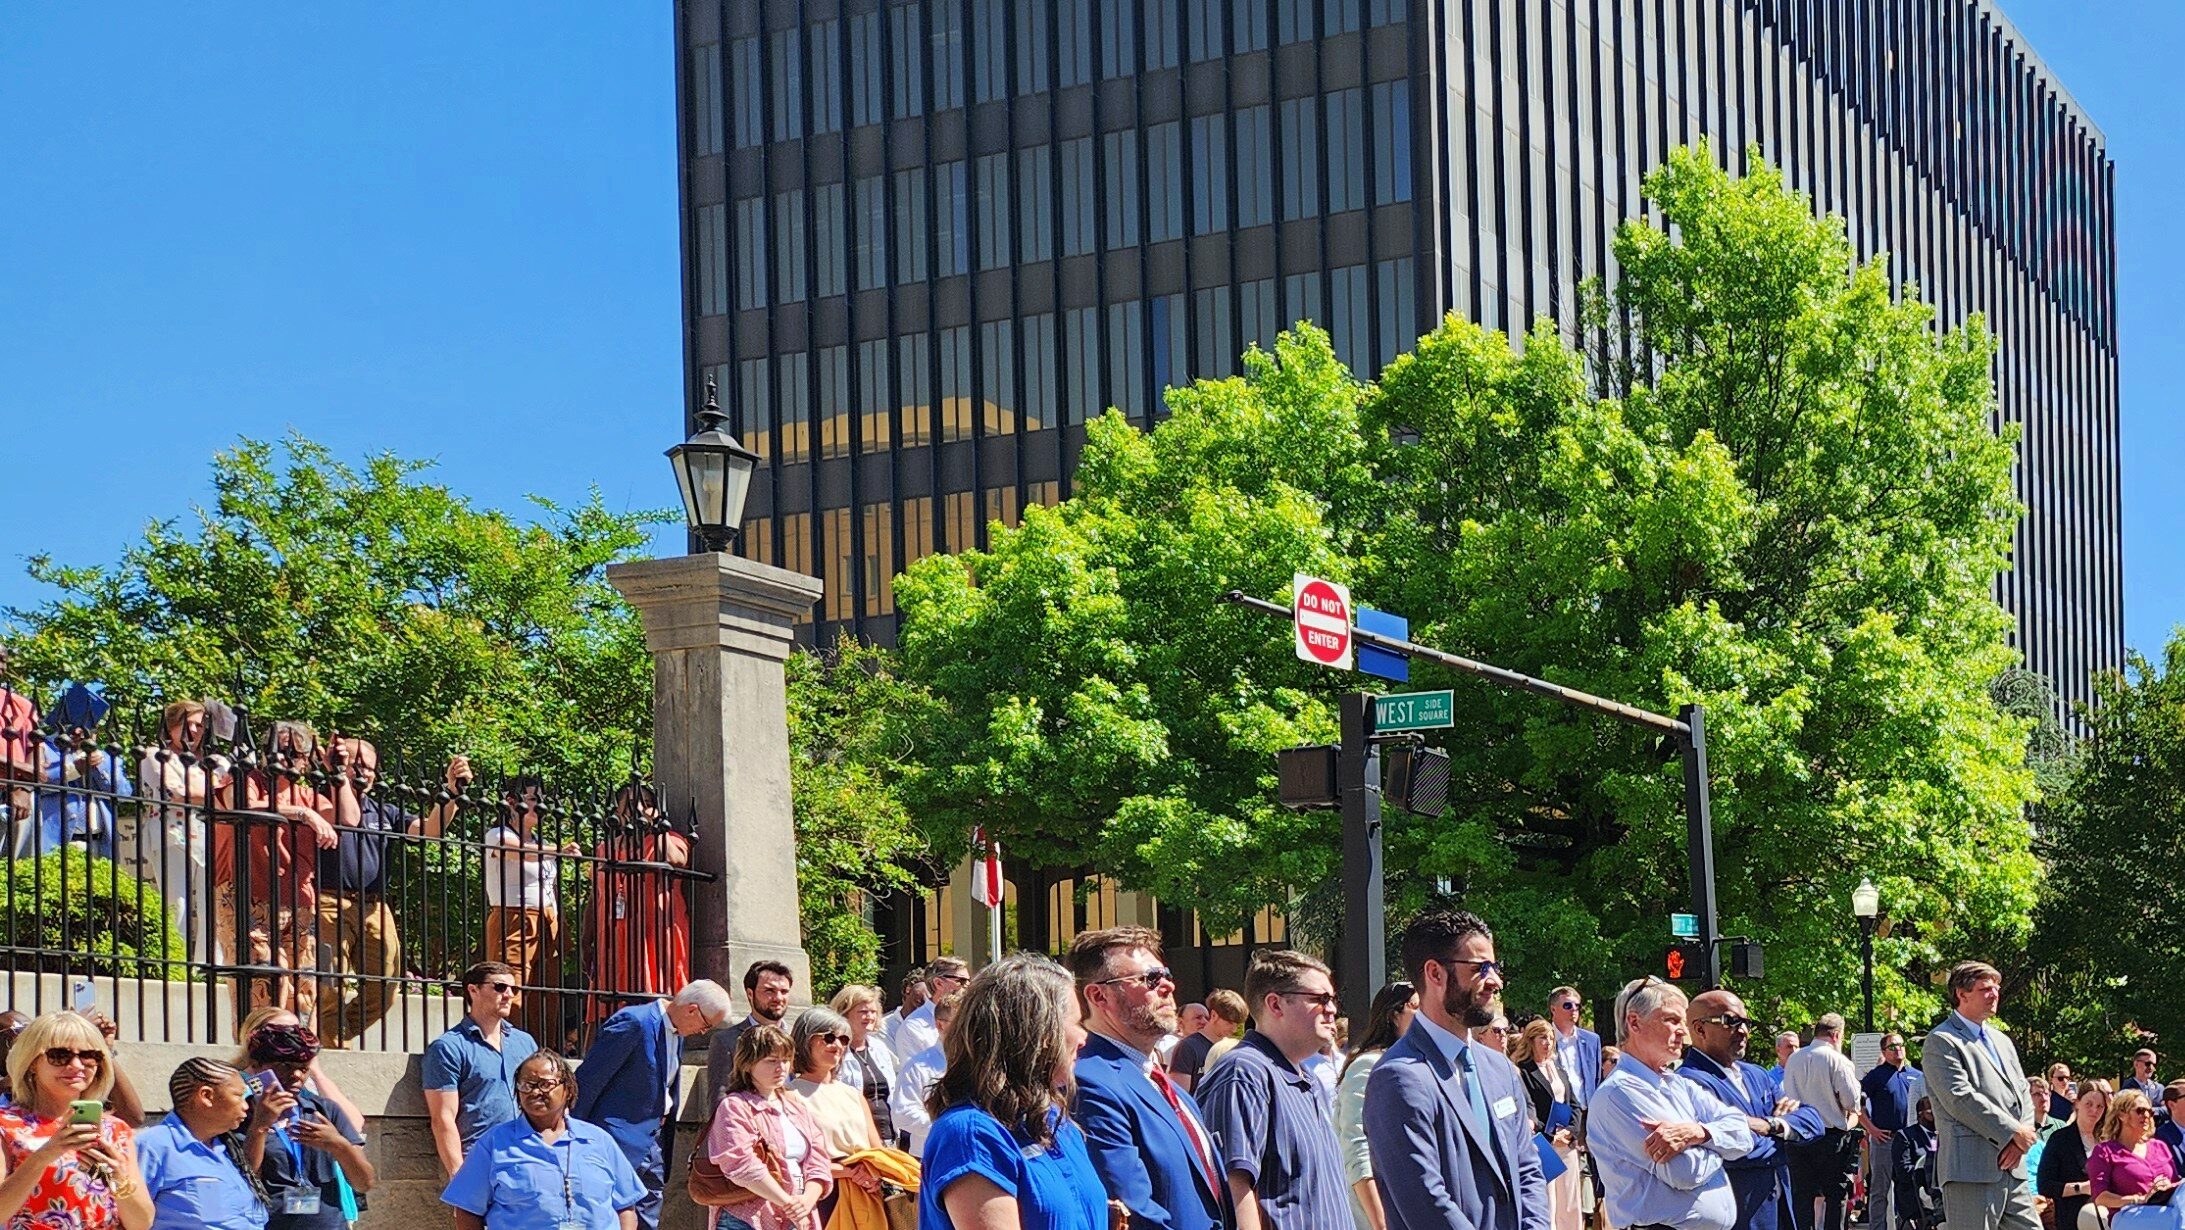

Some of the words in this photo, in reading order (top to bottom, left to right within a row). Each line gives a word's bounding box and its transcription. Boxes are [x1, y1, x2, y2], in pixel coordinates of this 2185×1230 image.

[1303, 592, 1318, 609] DO
[1321, 597, 1342, 615] NOT
[1308, 630, 1340, 651] ENTER
[1375, 700, 1415, 725] WEST
[1424, 698, 1442, 710] SIDE
[1418, 709, 1449, 722] SQUARE
